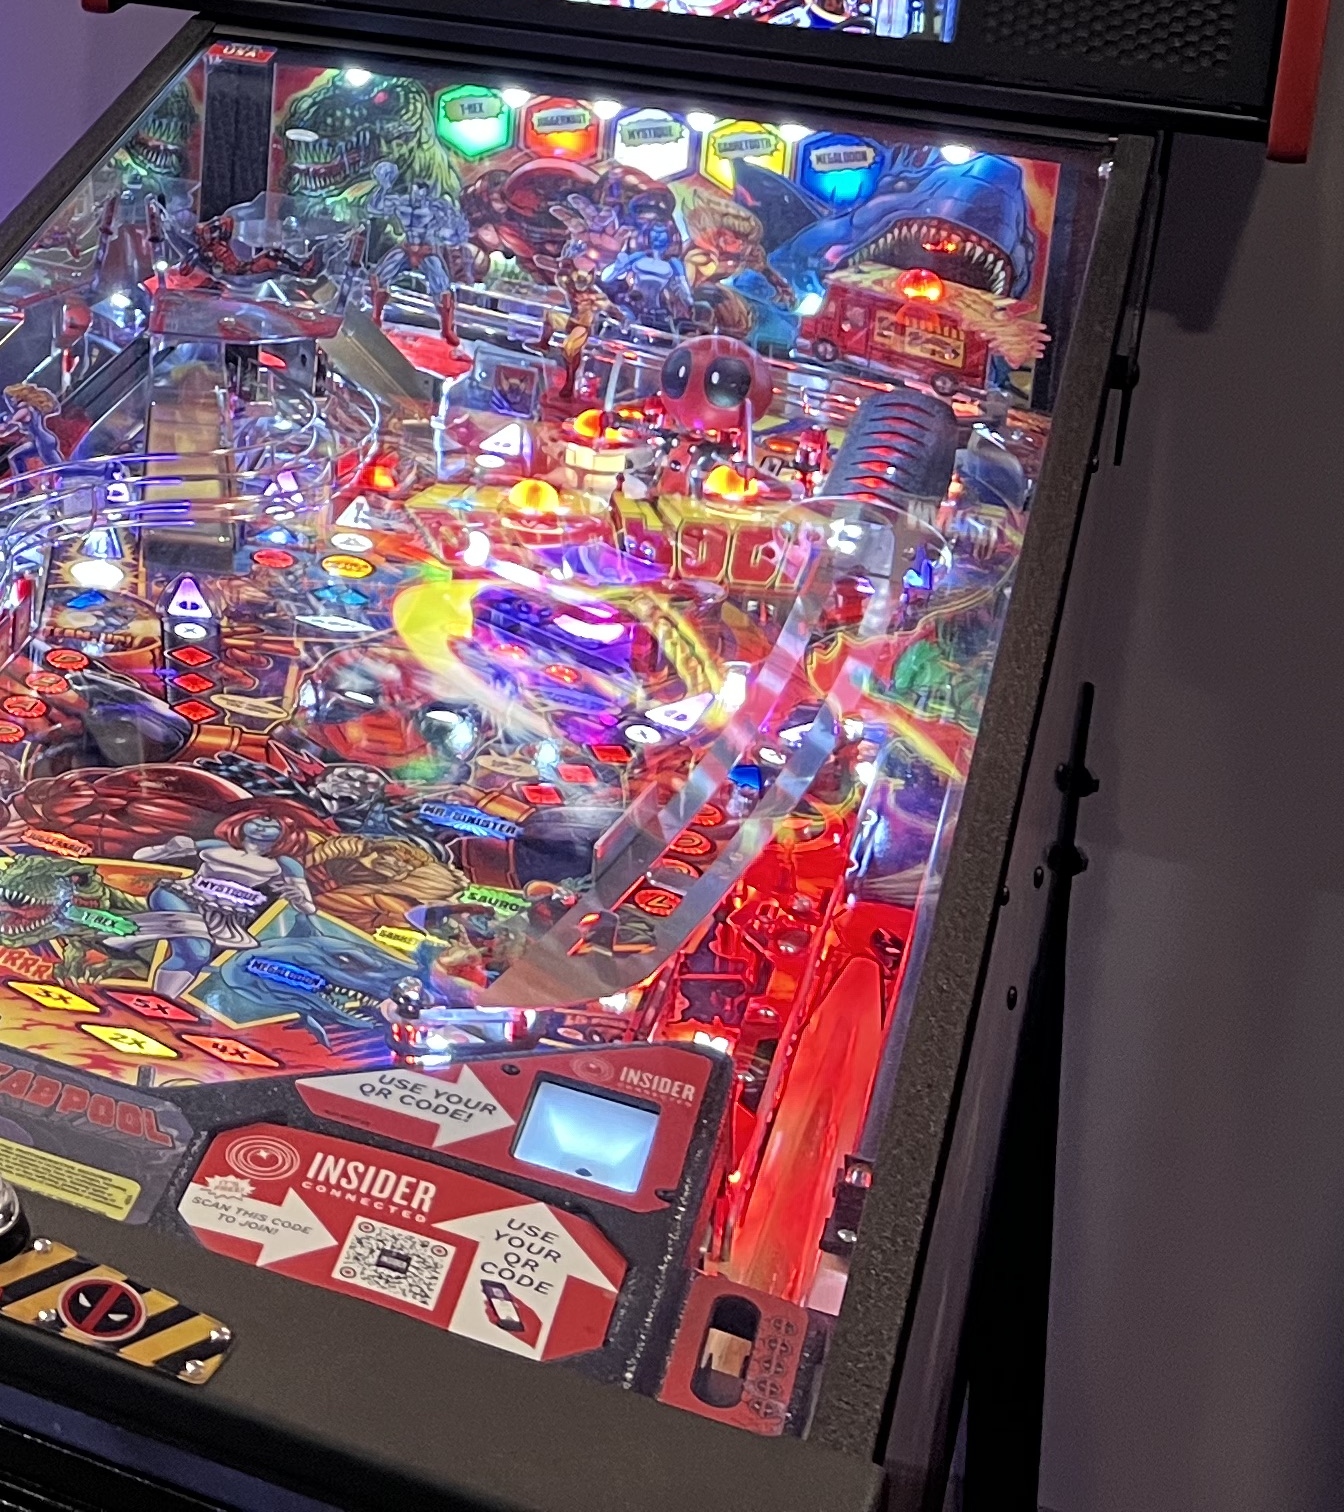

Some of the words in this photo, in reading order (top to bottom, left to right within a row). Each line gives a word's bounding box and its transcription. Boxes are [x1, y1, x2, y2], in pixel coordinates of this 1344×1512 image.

[460, 101, 484, 115] T-REX
[627, 125, 674, 140] MYSTIQUE
[451, 809, 517, 835] SINISTER
[467, 891, 521, 912] SAURO
[37, 986, 73, 1005] 3X
[134, 997, 173, 1016] 5X
[109, 1032, 147, 1051] 2X
[211, 1043, 250, 1060] 4X
[378, 1073, 428, 1095] USE
[433, 1088, 498, 1116] YOUR
[618, 1066, 696, 1103] INSIDER
[358, 1082, 399, 1102] QR
[398, 1093, 474, 1124] CODE!
[306, 1151, 437, 1213] INSIDER
[191, 1195, 231, 1212] SCAN
[236, 1206, 269, 1222] THIS
[271, 1216, 315, 1235] CODE
[301, 1180, 428, 1224] CONNECTED
[217, 1212, 237, 1224] TO
[238, 1219, 279, 1236] JOIN!
[507, 1218, 560, 1245] USE
[494, 1229, 562, 1264] YOUR
[503, 1251, 540, 1273] QR
[480, 1261, 554, 1296] CODE
